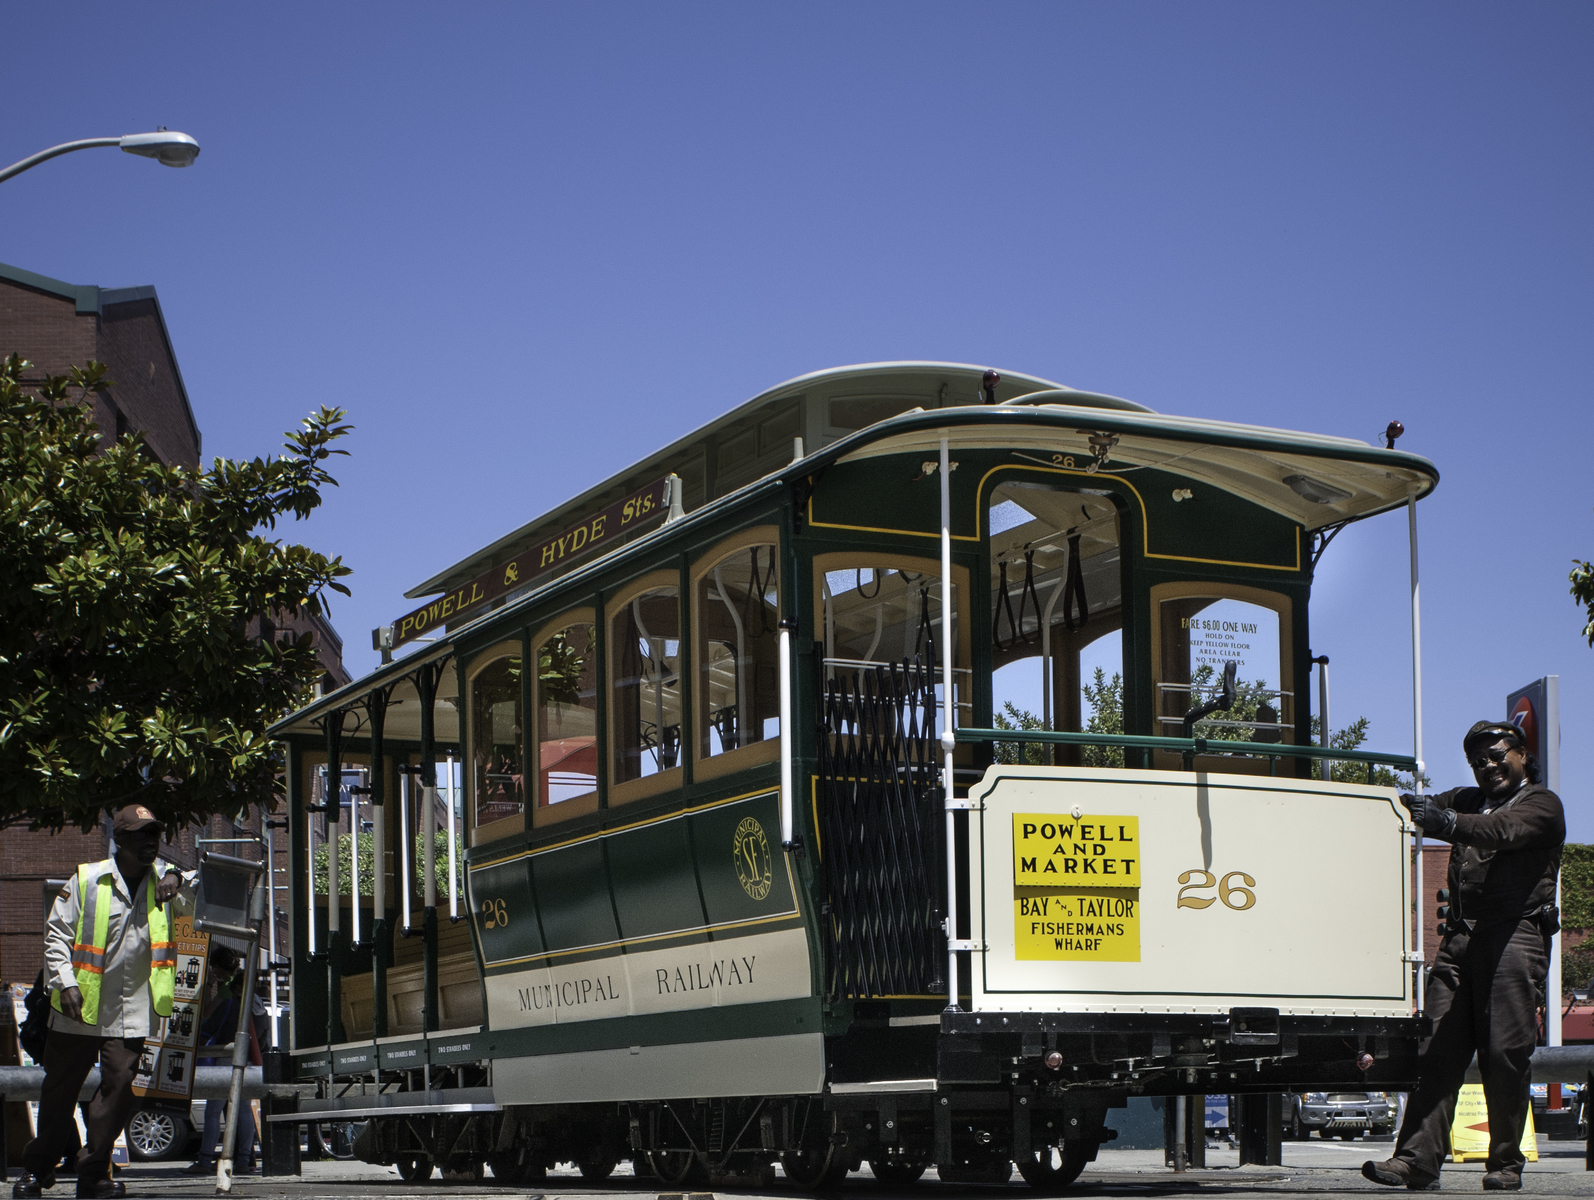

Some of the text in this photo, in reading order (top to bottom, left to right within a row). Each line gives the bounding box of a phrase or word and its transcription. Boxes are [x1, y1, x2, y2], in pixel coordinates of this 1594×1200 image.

[1052, 454, 1074, 468] 26
[399, 493, 656, 639] POWELL & HYDE Sts.
[1181, 617, 1258, 634] FARE $6.00 ONE WAY
[1205, 640, 1229, 648] YELLOW
[733, 818, 767, 856] MUNICIPAL
[1022, 823, 1133, 842] POWELL
[1052, 843, 1106, 856] AND
[1020, 856, 1136, 875] MARKET
[740, 867, 772, 899] RAILWAY
[1177, 869, 1257, 911] 26
[481, 897, 509, 930] 26
[1020, 897, 1134, 918] BAY AND TAYLOR
[1031, 921, 1125, 936] FISHERMANS
[177, 942, 206, 953] ETY TIPS
[1054, 938, 1103, 951] WHARF
[517, 955, 757, 1012] MUNICIPAL RAILWAY
